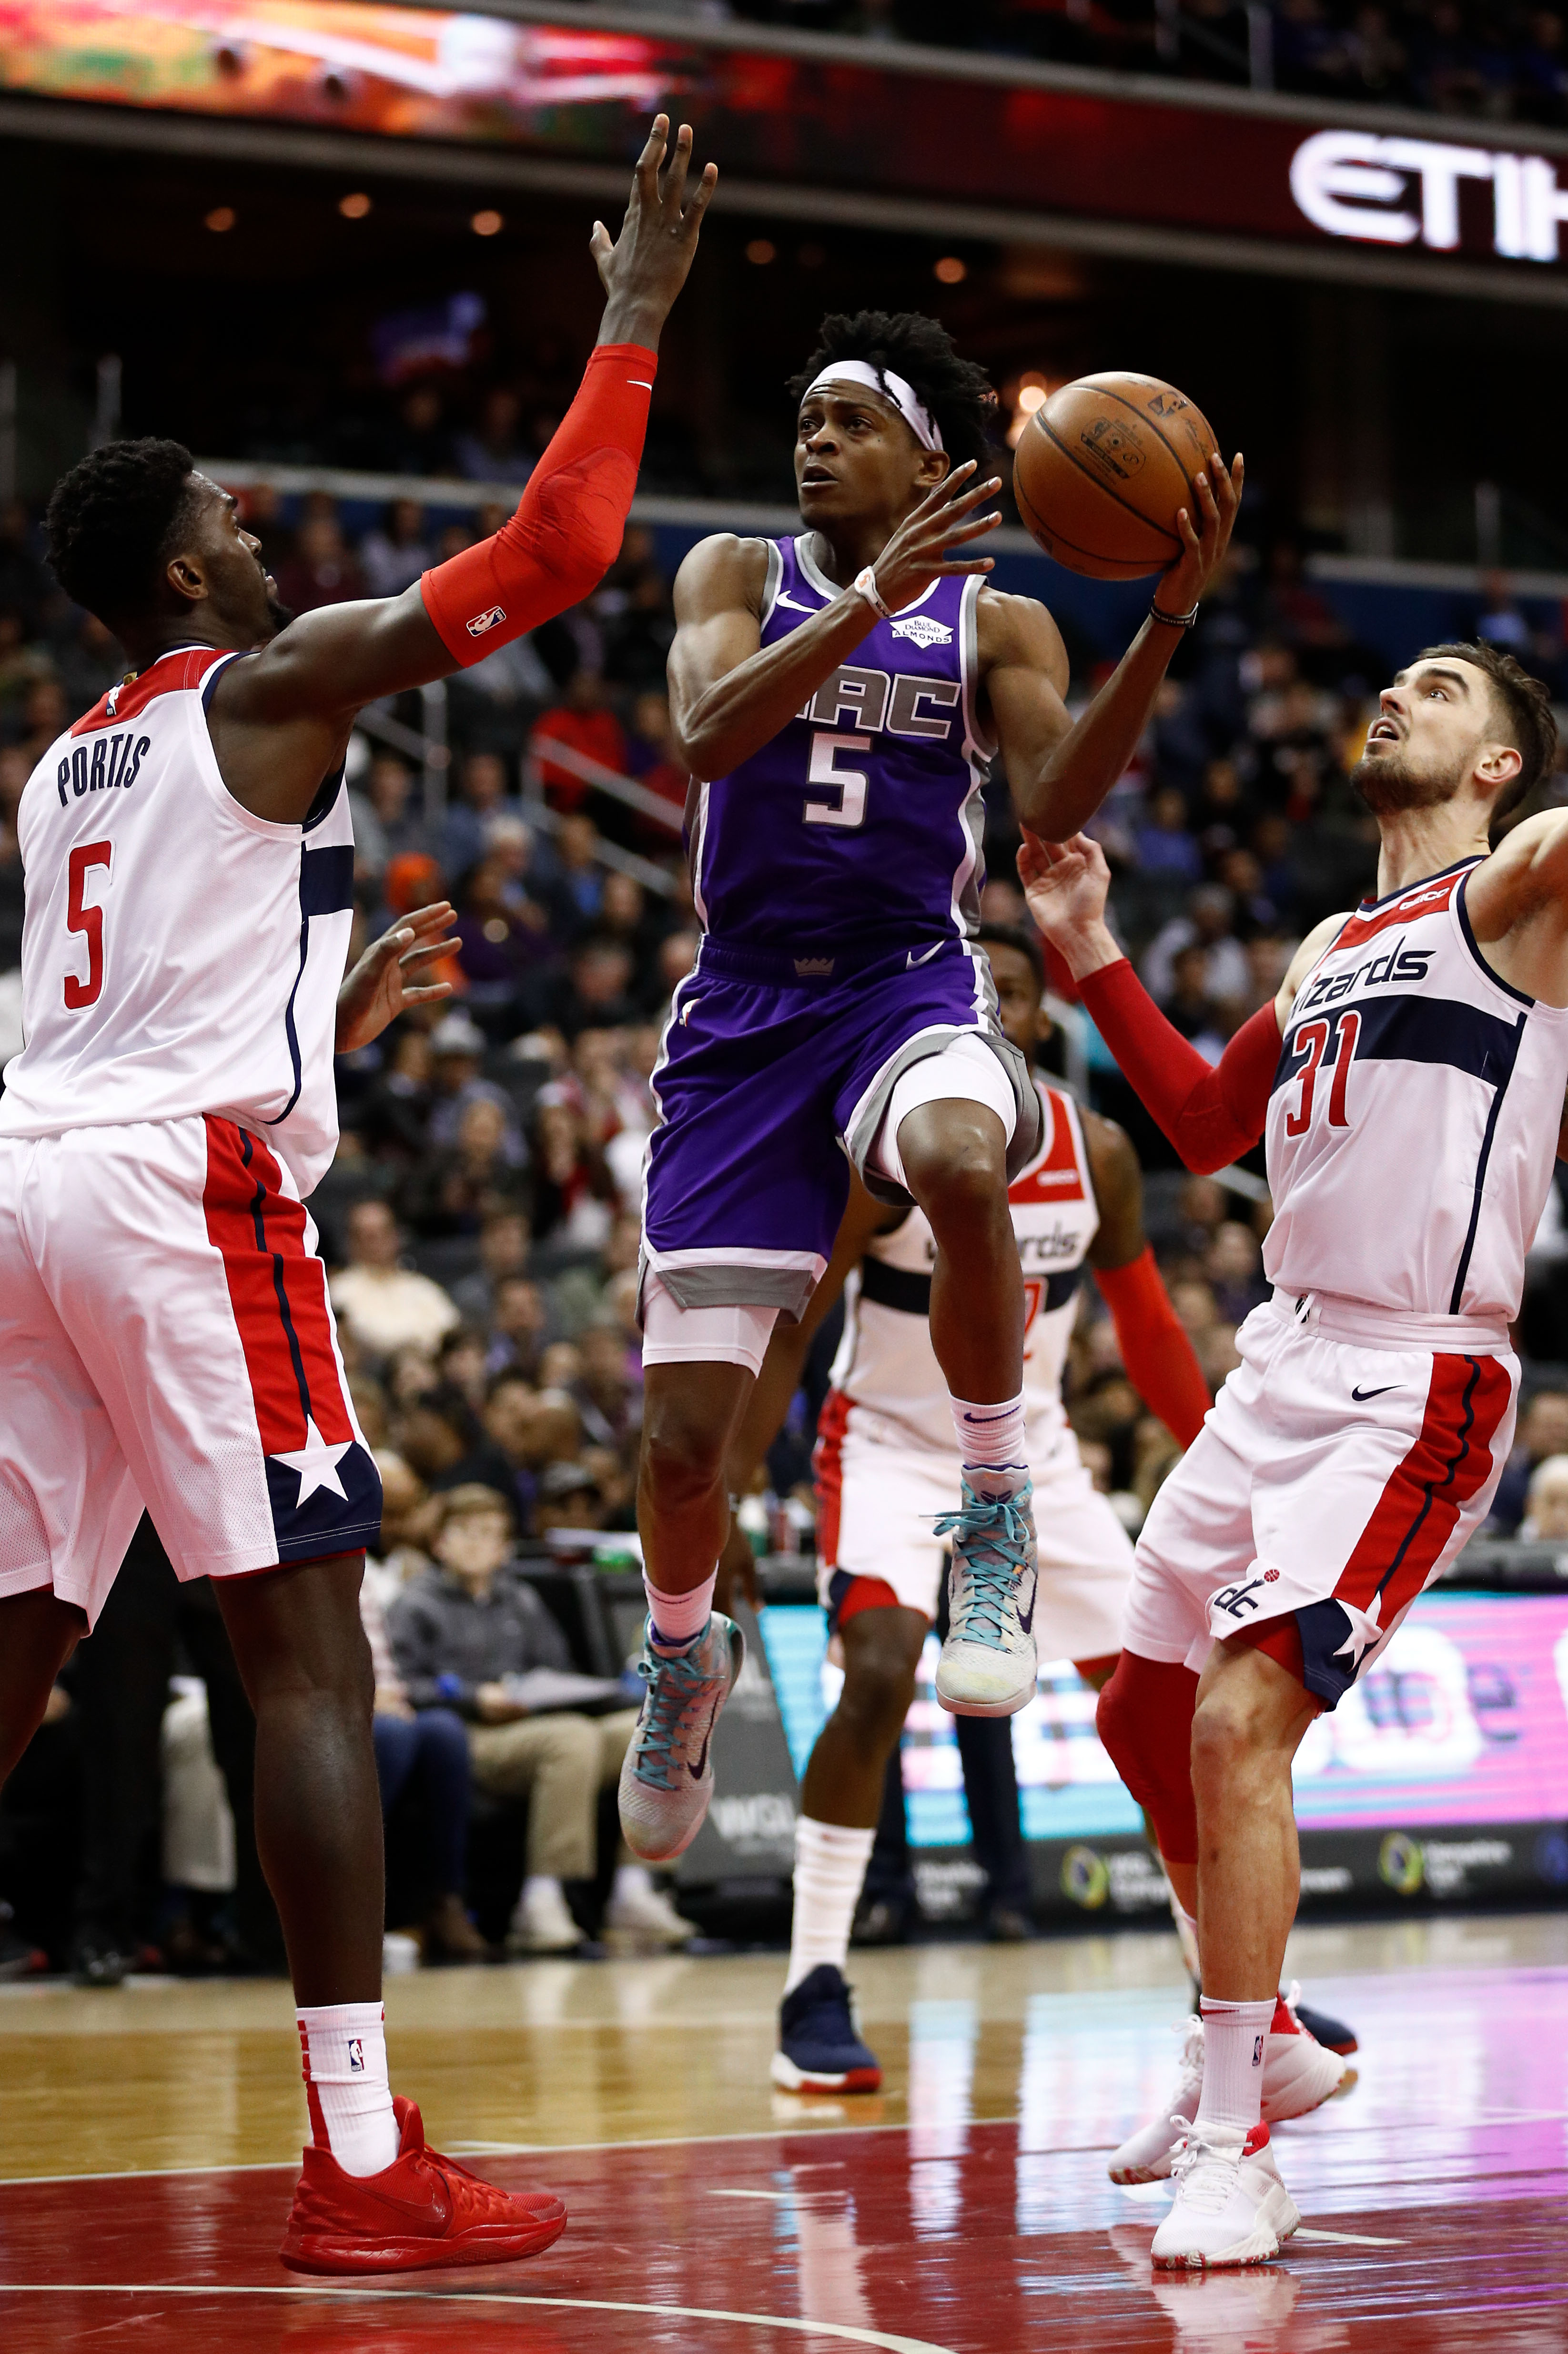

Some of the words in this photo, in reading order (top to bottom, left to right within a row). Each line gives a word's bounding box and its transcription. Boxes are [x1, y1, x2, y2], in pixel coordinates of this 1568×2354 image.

[1289, 129, 1568, 263] ETIH
[895, 630, 950, 643] ALMONDS
[795, 664, 961, 739] AC
[58, 733, 151, 807] PORTIS
[802, 731, 872, 828] 5
[63, 839, 113, 1011] 5
[1285, 1011, 1360, 1138] 31
